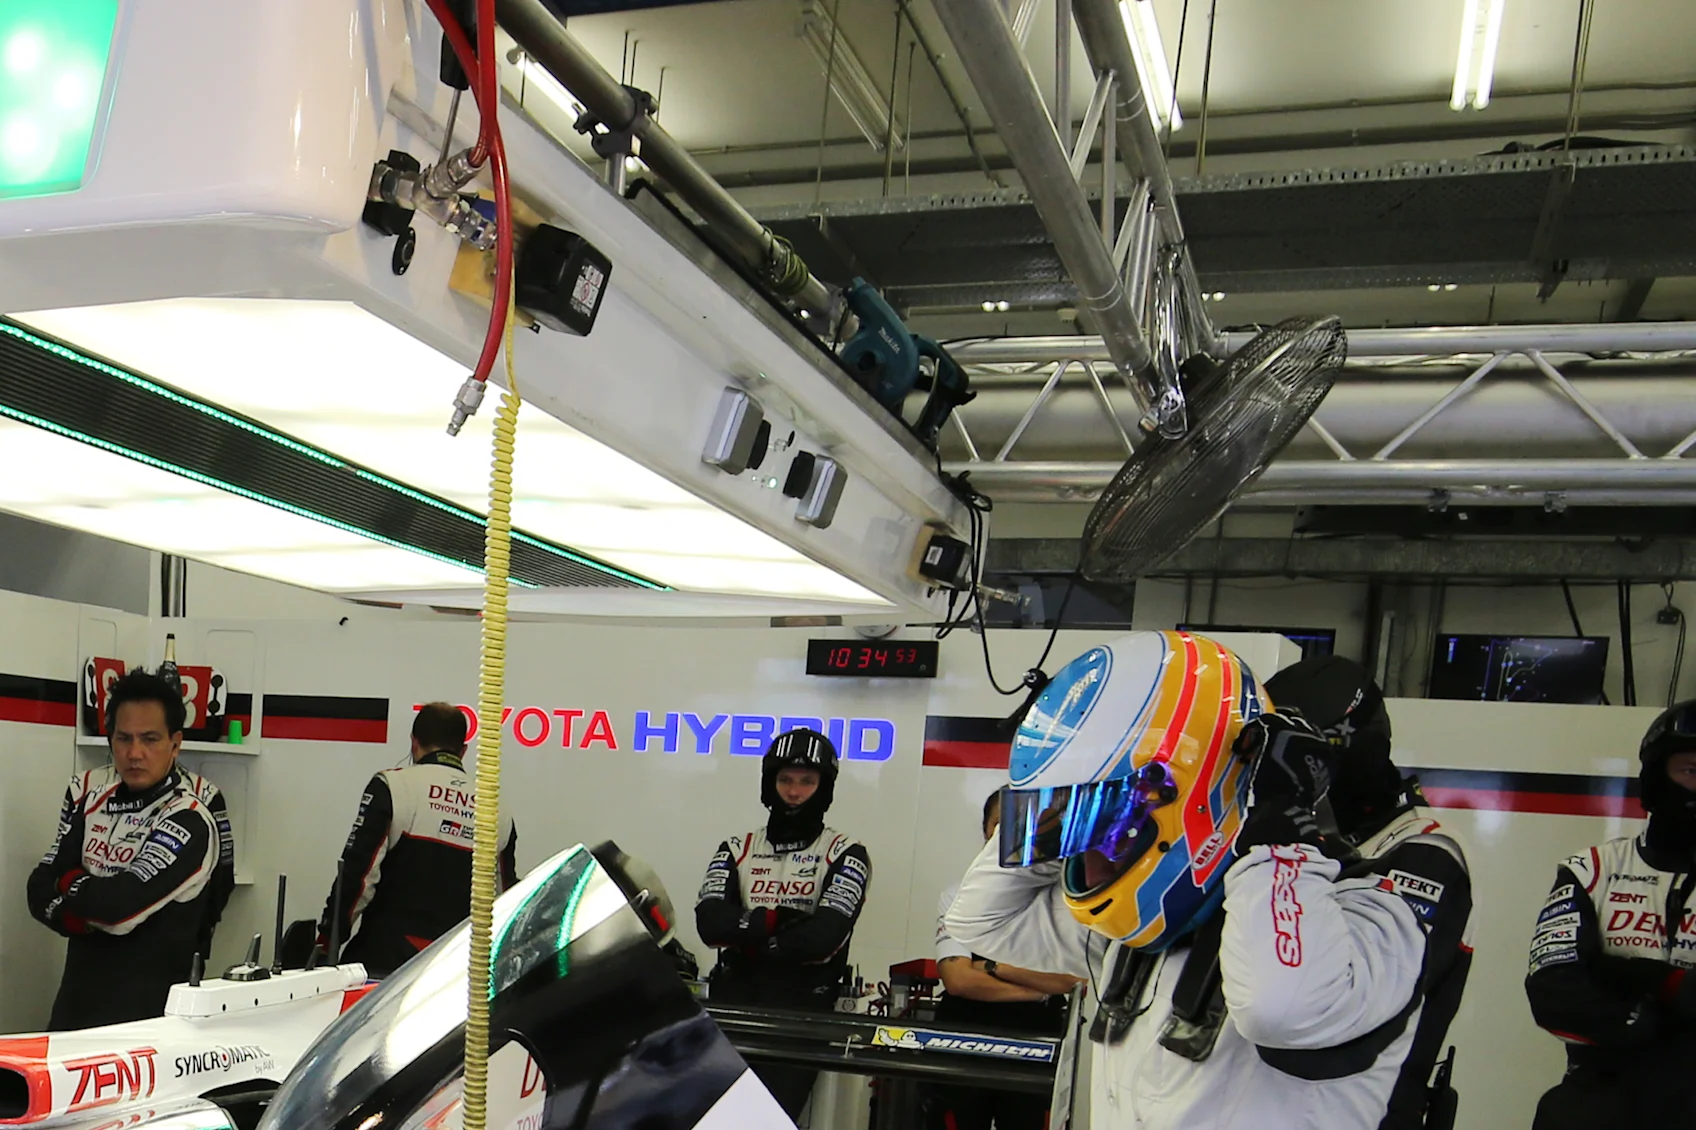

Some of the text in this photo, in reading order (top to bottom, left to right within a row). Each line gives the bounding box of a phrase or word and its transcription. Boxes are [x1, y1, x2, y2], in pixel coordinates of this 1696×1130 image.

[828, 648, 917, 668] 10 34 53
[413, 704, 619, 751] OTA
[108, 801, 134, 812] Mobil
[429, 784, 476, 810] DENS
[429, 802, 460, 816] TOYOTA
[440, 824, 459, 837] GR
[85, 838, 134, 863] DENSO
[1194, 835, 1222, 866] BELL
[750, 880, 815, 896] DENSO
[1609, 892, 1647, 904] ZENT
[750, 896, 779, 905] TOYOTA
[1607, 910, 1696, 937] DEN
[1606, 937, 1660, 950] TOYOTA
[926, 1037, 1050, 1058] MICHELIN
[175, 1045, 271, 1077] SYNCROMATIC
[62, 1046, 158, 1114] ZENT
